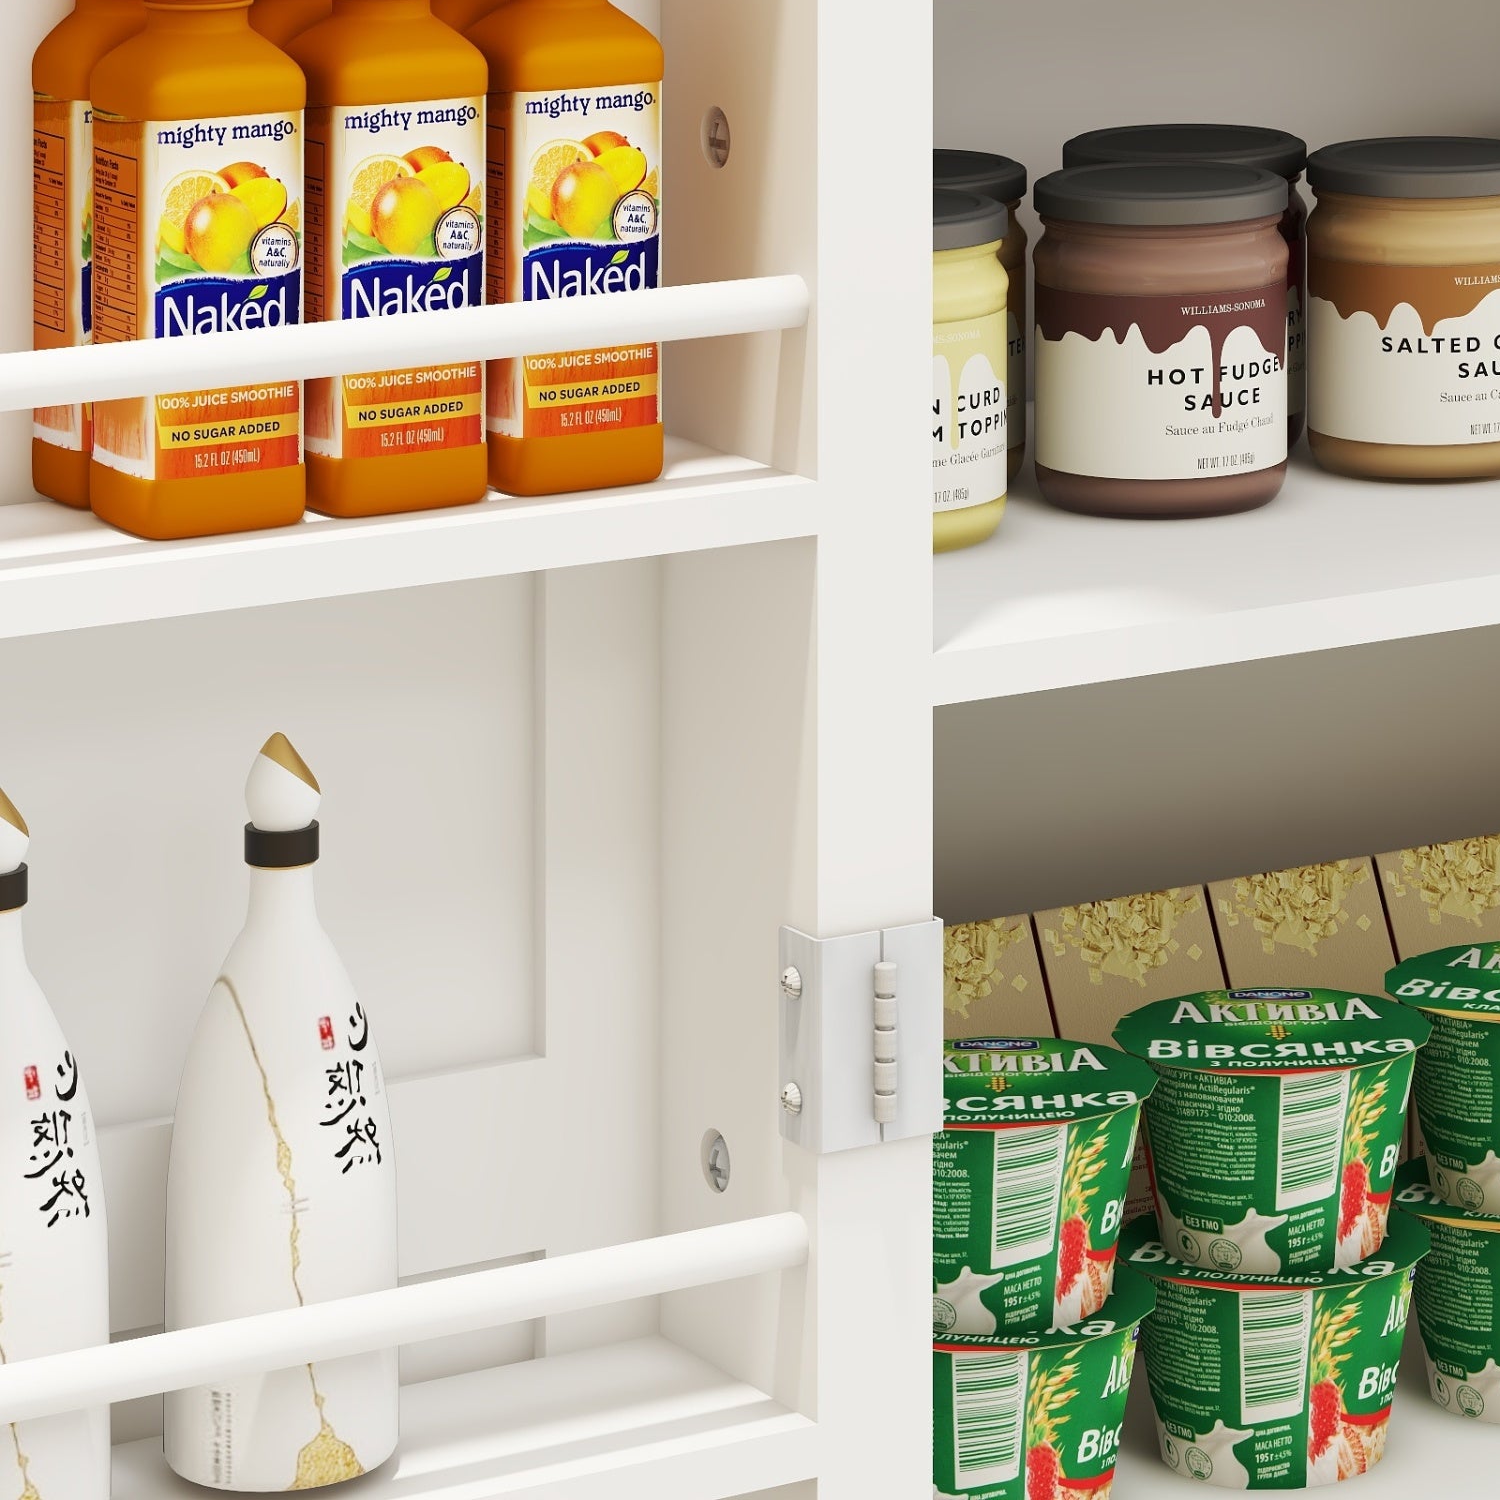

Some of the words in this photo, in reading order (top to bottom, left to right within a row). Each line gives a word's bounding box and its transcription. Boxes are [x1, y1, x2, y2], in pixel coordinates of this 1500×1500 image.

[525, 94, 591, 118] mighty
[344, 108, 411, 133] mighty
[157, 123, 227, 149] mighty
[623, 203, 651, 214] vitamins
[445, 220, 474, 230] vitamins
[620, 224, 650, 235] naturally
[262, 237, 292, 247] vitamins
[443, 241, 473, 251] naturally
[258, 259, 291, 269] naturally
[532, 252, 646, 302] Naked
[351, 268, 469, 320] Naked
[162, 286, 286, 340] Naked
[1181, 299, 1265, 315] WILLIAMS-SONOMA
[1381, 336, 1481, 353] SALTED
[527, 356, 556, 370] 100%
[558, 353, 592, 368] JUICE
[594, 347, 653, 365] SMOOTHIE
[345, 376, 377, 390] 100%
[378, 373, 413, 388] JUICE
[416, 366, 477, 383] SMOOTHIE
[1147, 368, 1204, 385] HOT
[1219, 356, 1280, 381] FUDGE
[158, 396, 190, 410] 100%
[192, 393, 228, 408] JUICE
[231, 385, 294, 403] SMOOTHIE
[539, 390, 557, 402] NO
[559, 386, 600, 400] SUGAR
[602, 381, 641, 396] ADDED
[957, 387, 1000, 412] CURD
[1184, 387, 1260, 411] SAUCE
[1440, 391, 1472, 403] Sauce
[1475, 393, 1487, 402] au
[358, 409, 377, 422] NO
[380, 406, 421, 419] SUGAR
[423, 401, 464, 415] ADDED
[171, 431, 190, 442] NO
[194, 426, 235, 440] SUGAR
[238, 421, 280, 435] ADDED
[1165, 424, 1199, 436] Sauce
[1202, 426, 1215, 435] au
[1218, 420, 1248, 434] Fudgé
[1470, 424, 1481, 435] NET
[380, 432, 394, 447] 15.2
[396, 431, 404, 446] FL
[406, 430, 415, 445] OZ
[195, 454, 208, 469] 15.2
[210, 453, 219, 467] FL
[220, 451, 230, 466] OZ
[950, 452, 979, 466] Glacée
[1197, 458, 1209, 470] NET
[1170, 998, 1382, 1025] АКТИВІА
[960, 1040, 1033, 1048] DANONE
[1148, 1038, 1416, 1060] Вівсянка
[1228, 1056, 1358, 1068] ПОЛУНИЦЕЮ
[943, 1111, 1076, 1121] ПОЛУНИЦЕЮ
[1185, 1215, 1200, 1227] БЕЗ
[1201, 1219, 1219, 1231] ГМО
[1196, 1270, 1324, 1285] ПОЛУНИЦЕЮ
